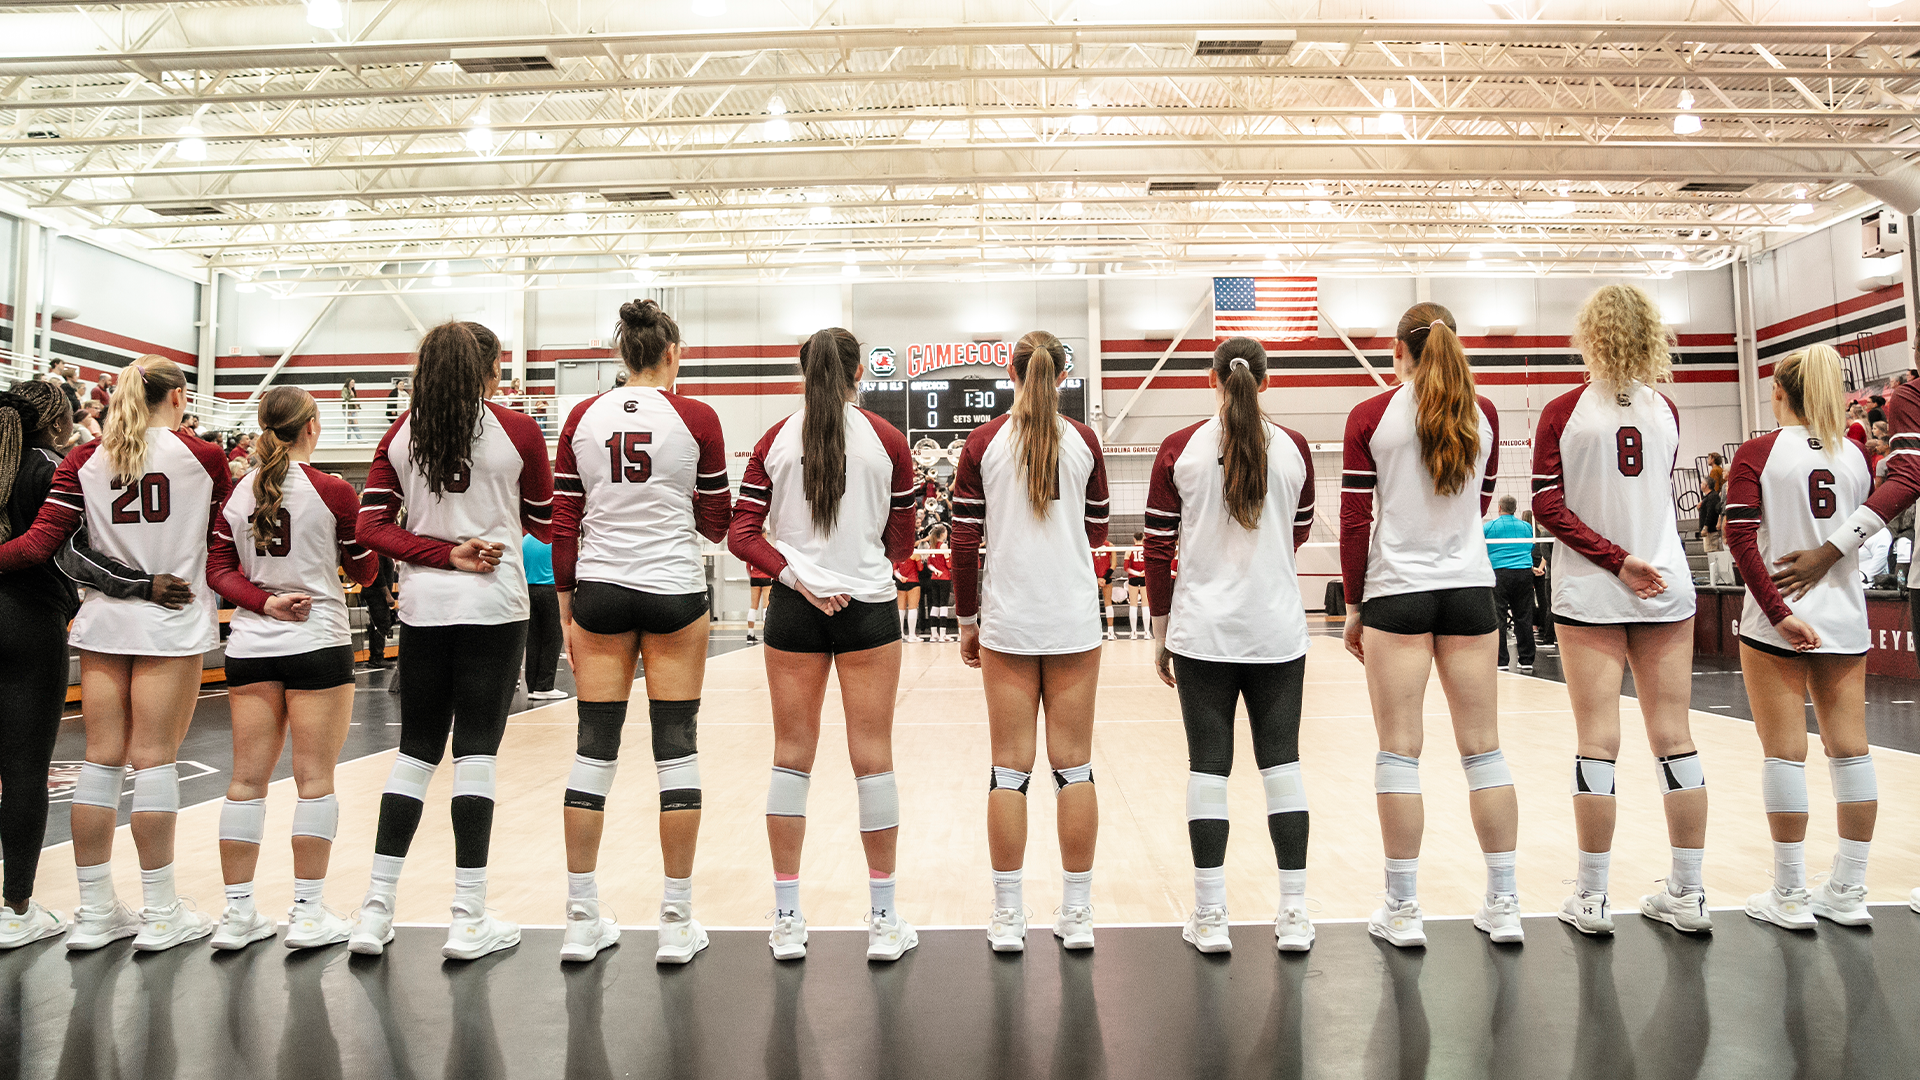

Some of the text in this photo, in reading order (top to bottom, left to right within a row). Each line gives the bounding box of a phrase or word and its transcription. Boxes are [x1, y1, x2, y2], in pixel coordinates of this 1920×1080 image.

[906, 342, 1014, 378] GAMECOC
[953, 414, 991, 423] SETS WON
[965, 391, 995, 408] 1:30
[605, 432, 652, 483] 15
[1616, 426, 1643, 477] 8
[110, 472, 171, 525] 20
[1808, 468, 1837, 519] 6
